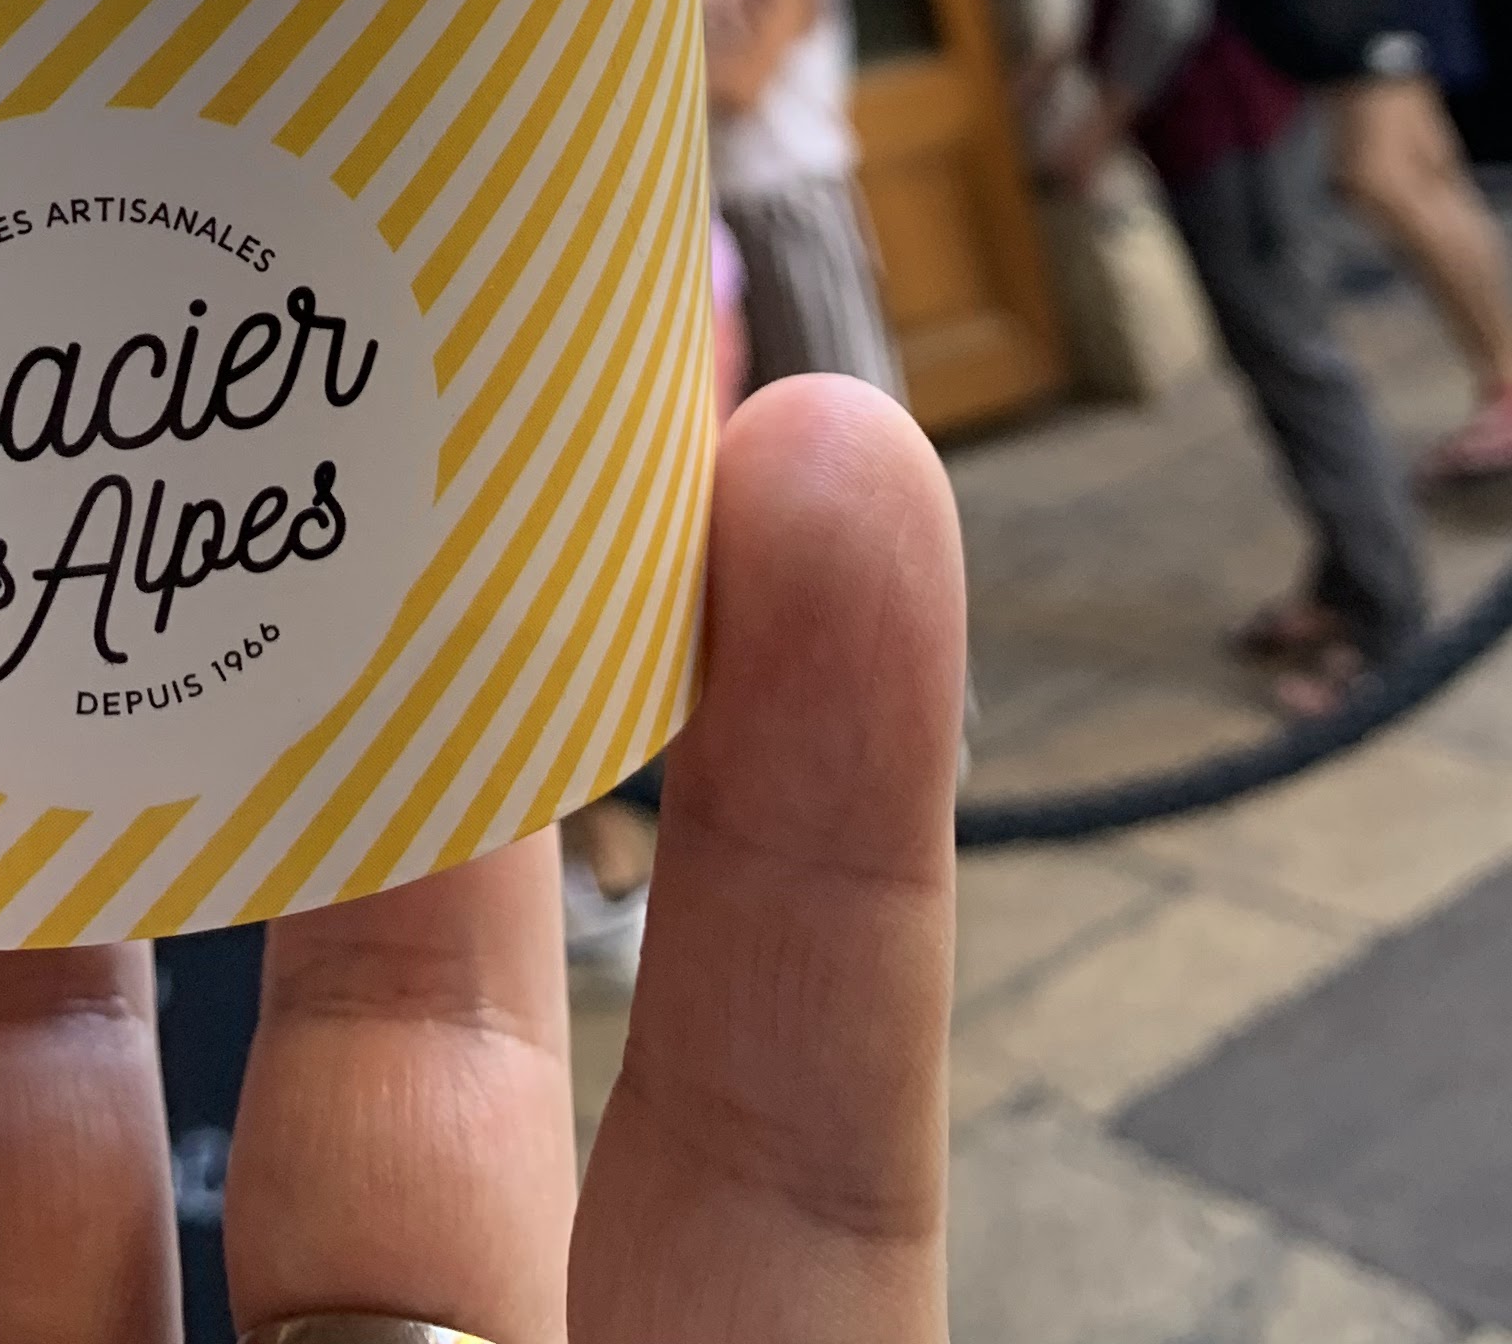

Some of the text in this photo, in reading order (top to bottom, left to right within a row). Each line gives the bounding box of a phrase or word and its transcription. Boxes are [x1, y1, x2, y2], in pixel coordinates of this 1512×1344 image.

[46, 196, 276, 273] ARTISANALES
[76, 622, 281, 716] DEPUIS 1966
